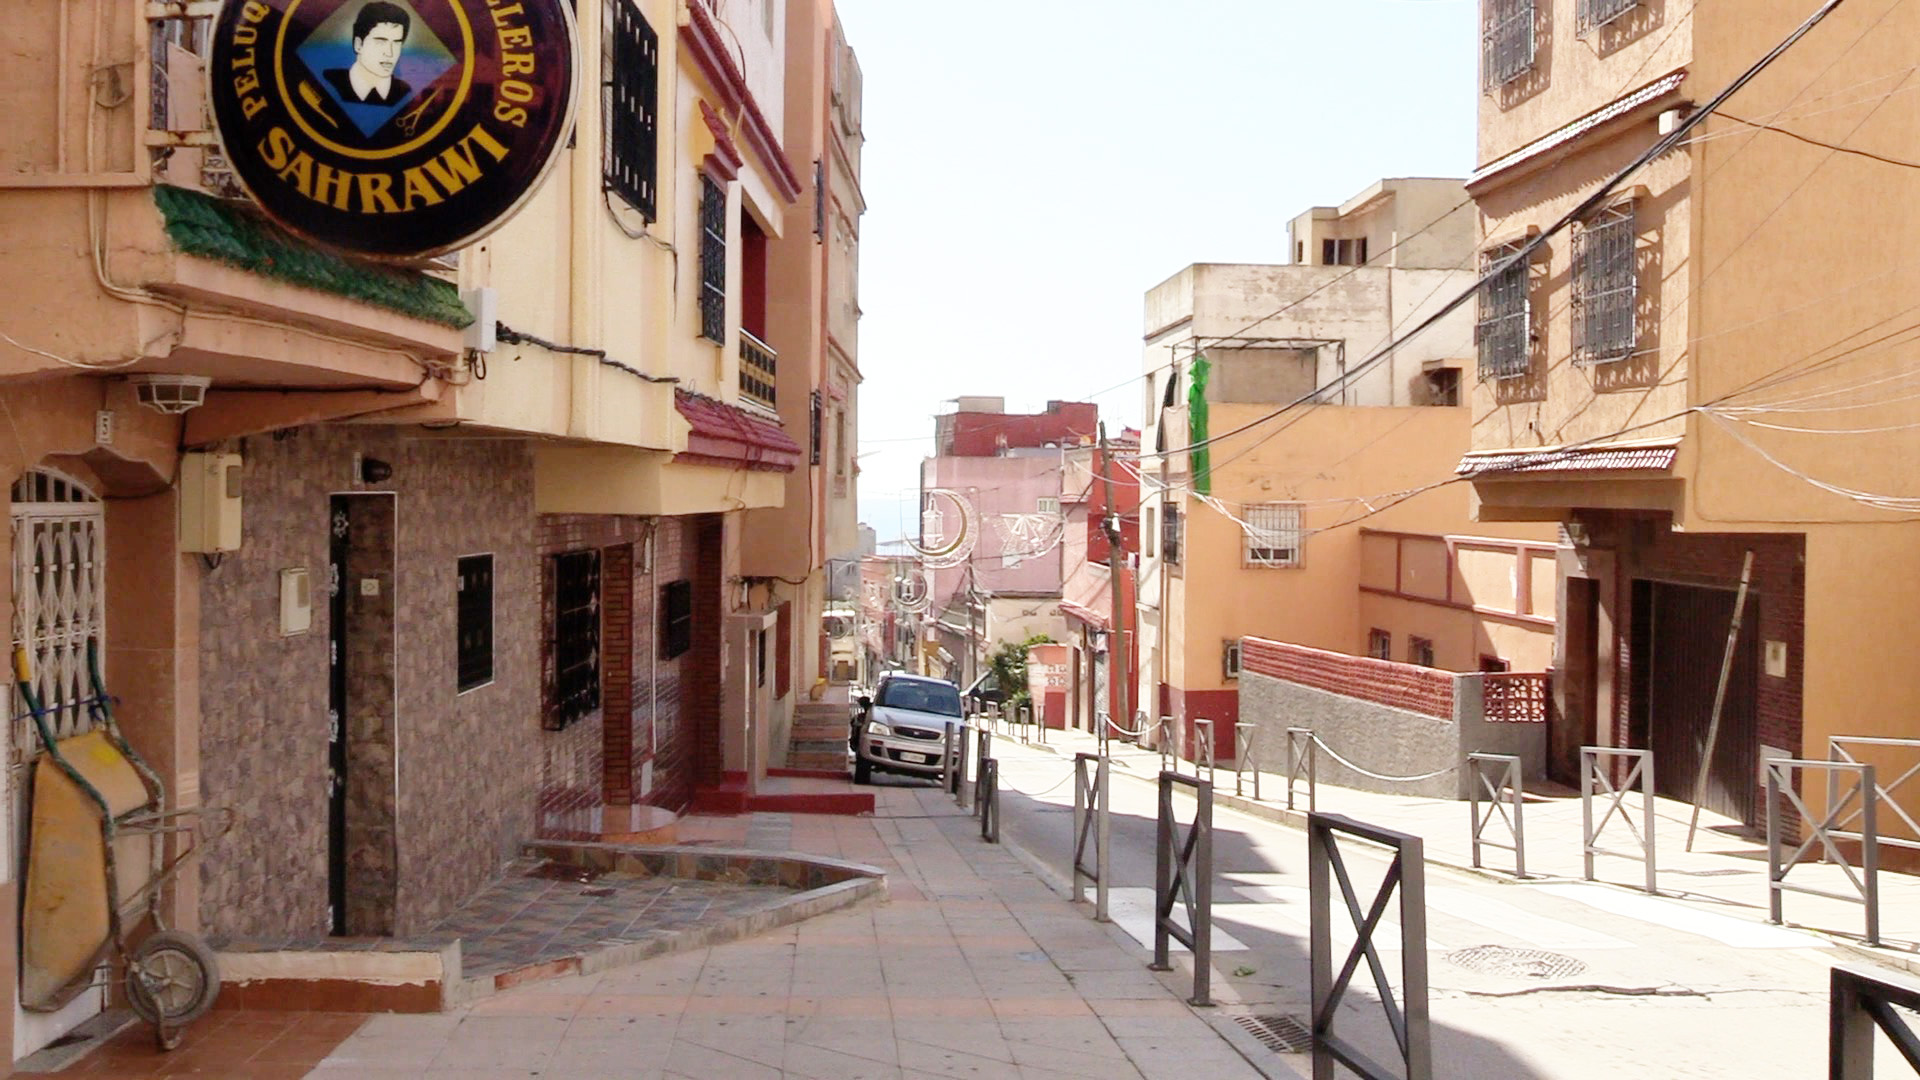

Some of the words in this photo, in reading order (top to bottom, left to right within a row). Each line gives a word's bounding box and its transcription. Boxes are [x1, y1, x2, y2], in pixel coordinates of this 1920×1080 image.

[232, 0, 270, 121] PELUQ
[486, 0, 534, 128] LEROS
[258, 123, 509, 214] SAHRAWI
